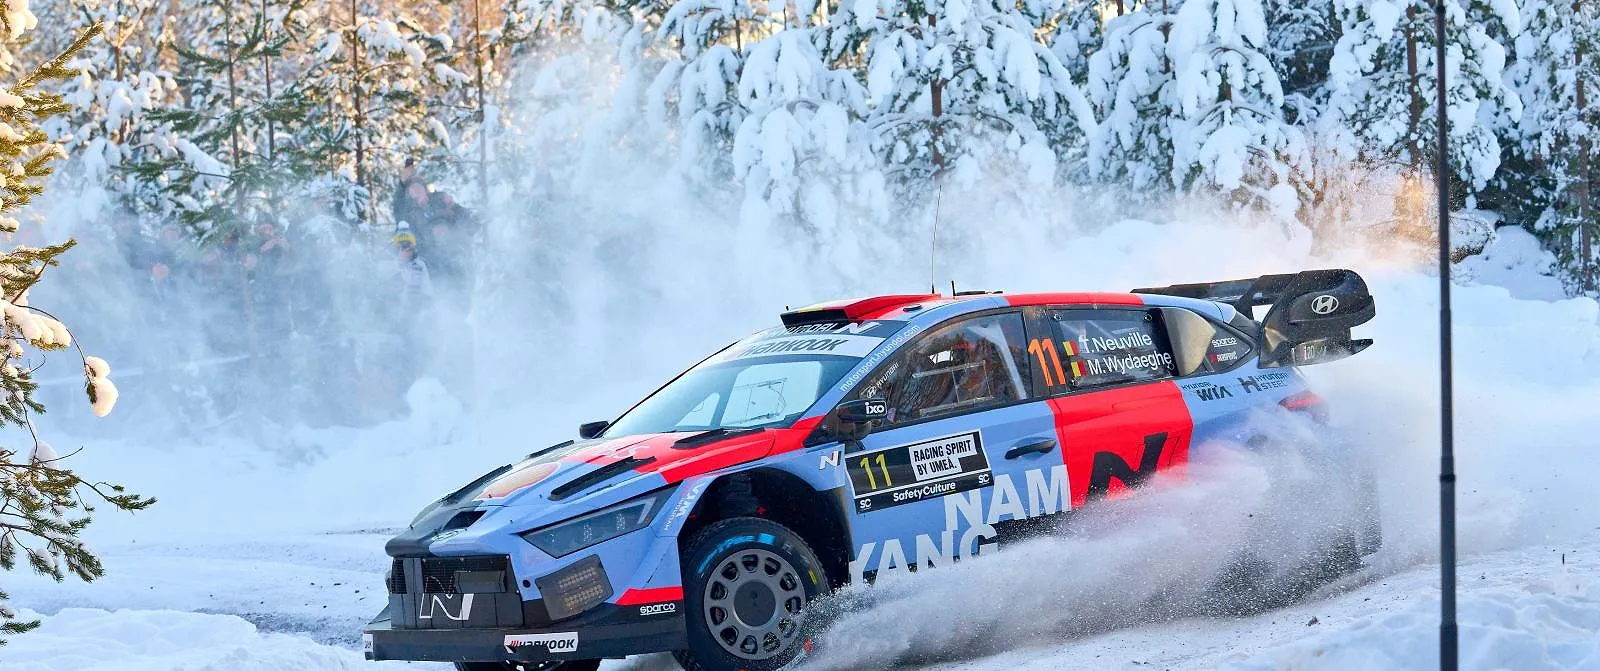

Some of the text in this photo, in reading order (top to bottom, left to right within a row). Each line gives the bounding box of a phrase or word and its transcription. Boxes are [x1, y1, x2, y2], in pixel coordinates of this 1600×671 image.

[1211, 337, 1238, 348] sparco
[839, 325, 921, 392] motorsport.hyundai.com
[1027, 338, 1066, 387] 11
[1260, 379, 1287, 390] STEEL
[913, 439, 972, 463] RACING SPIRIT
[859, 453, 892, 490] 11
[916, 463, 928, 476] BY
[978, 473, 990, 483] SC
[893, 482, 956, 502] SafetyCulture
[943, 464, 1072, 531] NAM
[859, 498, 872, 509] SC
[639, 602, 676, 616] sparco
